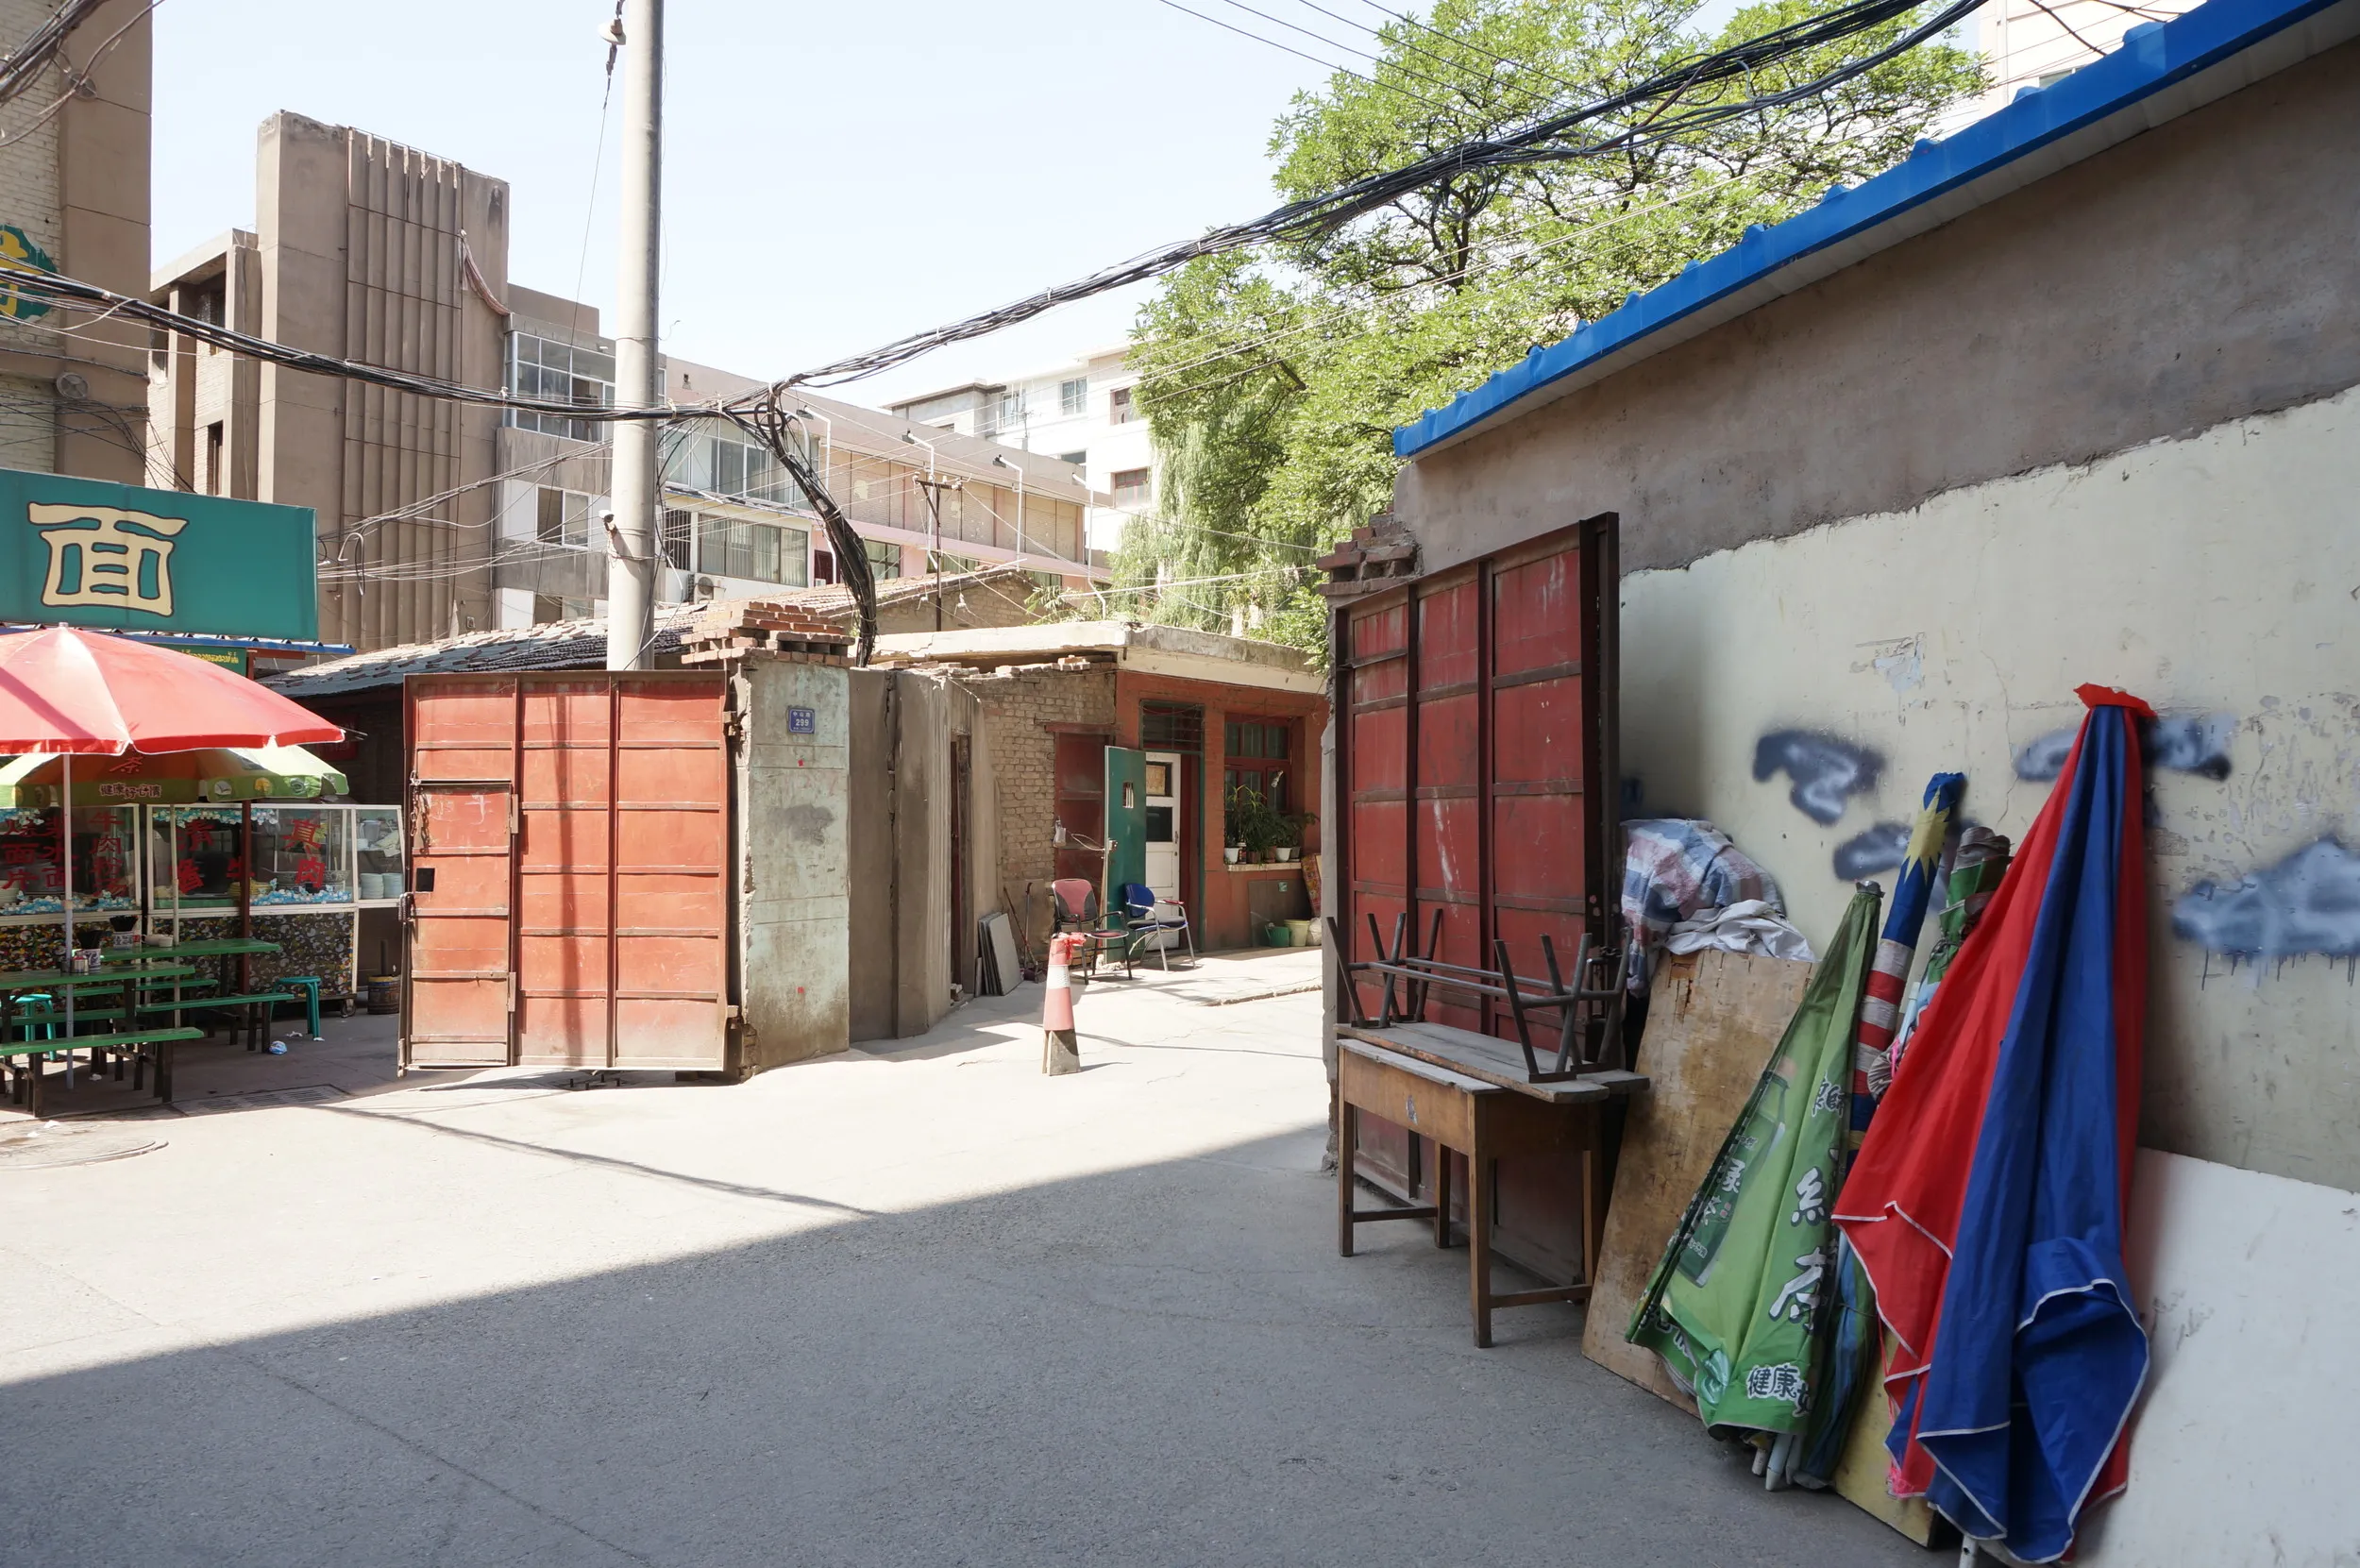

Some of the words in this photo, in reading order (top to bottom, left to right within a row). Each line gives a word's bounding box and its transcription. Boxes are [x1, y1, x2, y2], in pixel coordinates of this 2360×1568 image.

[27, 501, 189, 616] 面
[795, 718, 809, 727] 299
[99, 782, 161, 799] 健康好心情
